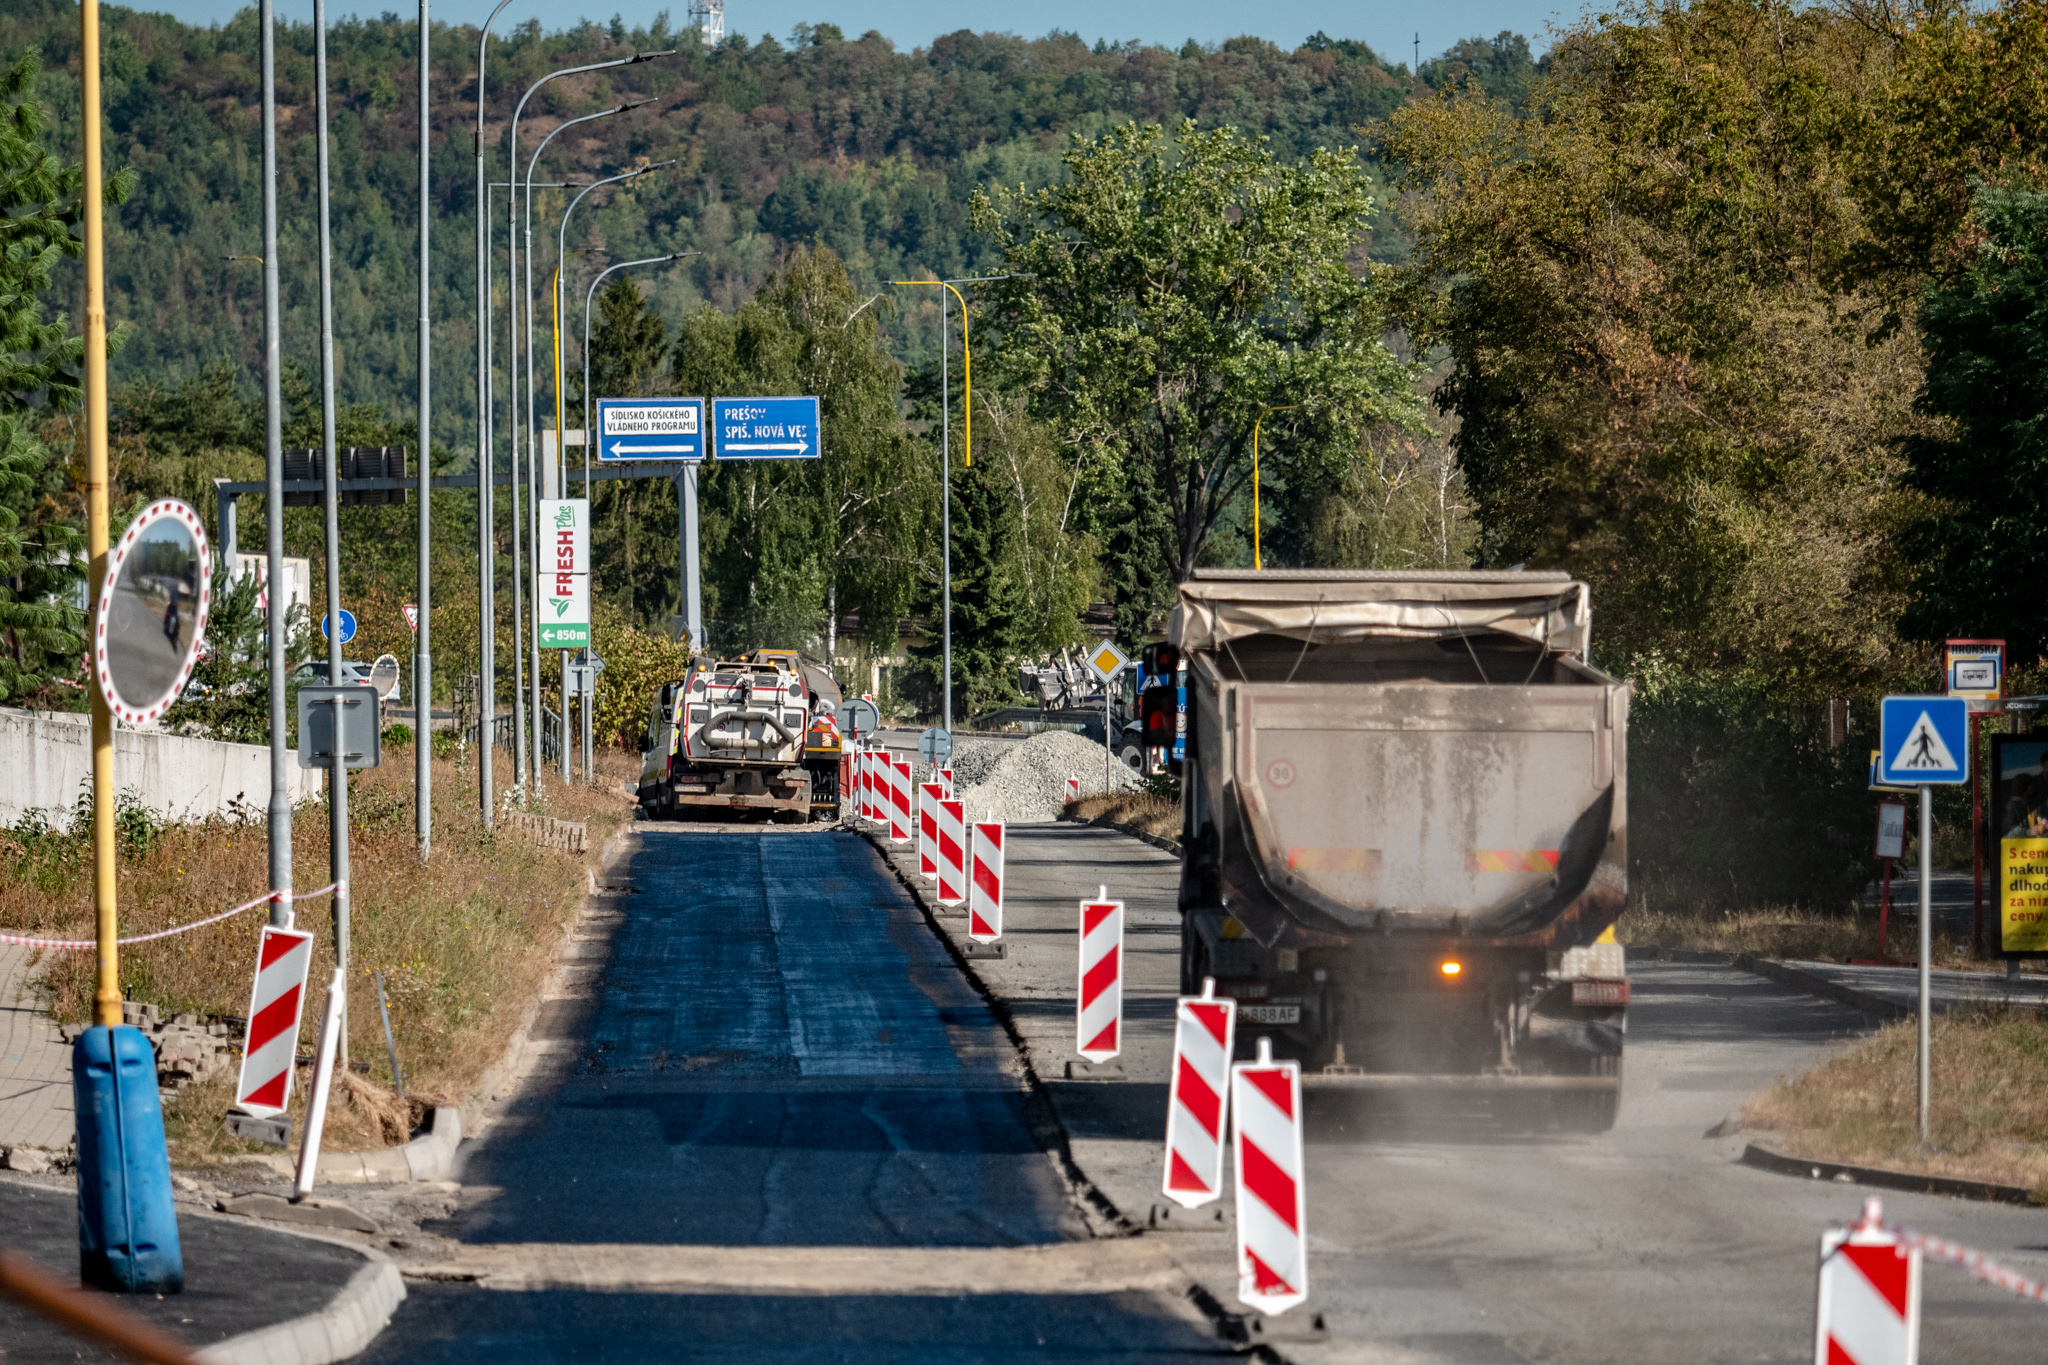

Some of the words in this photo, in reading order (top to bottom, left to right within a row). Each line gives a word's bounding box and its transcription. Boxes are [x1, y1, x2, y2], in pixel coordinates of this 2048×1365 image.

[611, 409, 645, 420] SÍDLISKO
[647, 408, 690, 420] KOŠICKÉHO
[724, 405, 766, 420] PREŠOV
[607, 420, 649, 431] VLÁDNEHO
[651, 421, 696, 431] PROGRAMU
[725, 422, 752, 439] SPIŠ.
[754, 422, 785, 438] NOVÁ
[787, 425, 807, 438] VES
[556, 531, 574, 596] FRESH
[556, 629, 587, 641] 850m
[2009, 848, 2017, 859] S
[2009, 898, 2025, 907] za
[2009, 912, 2047, 924] ceny.
